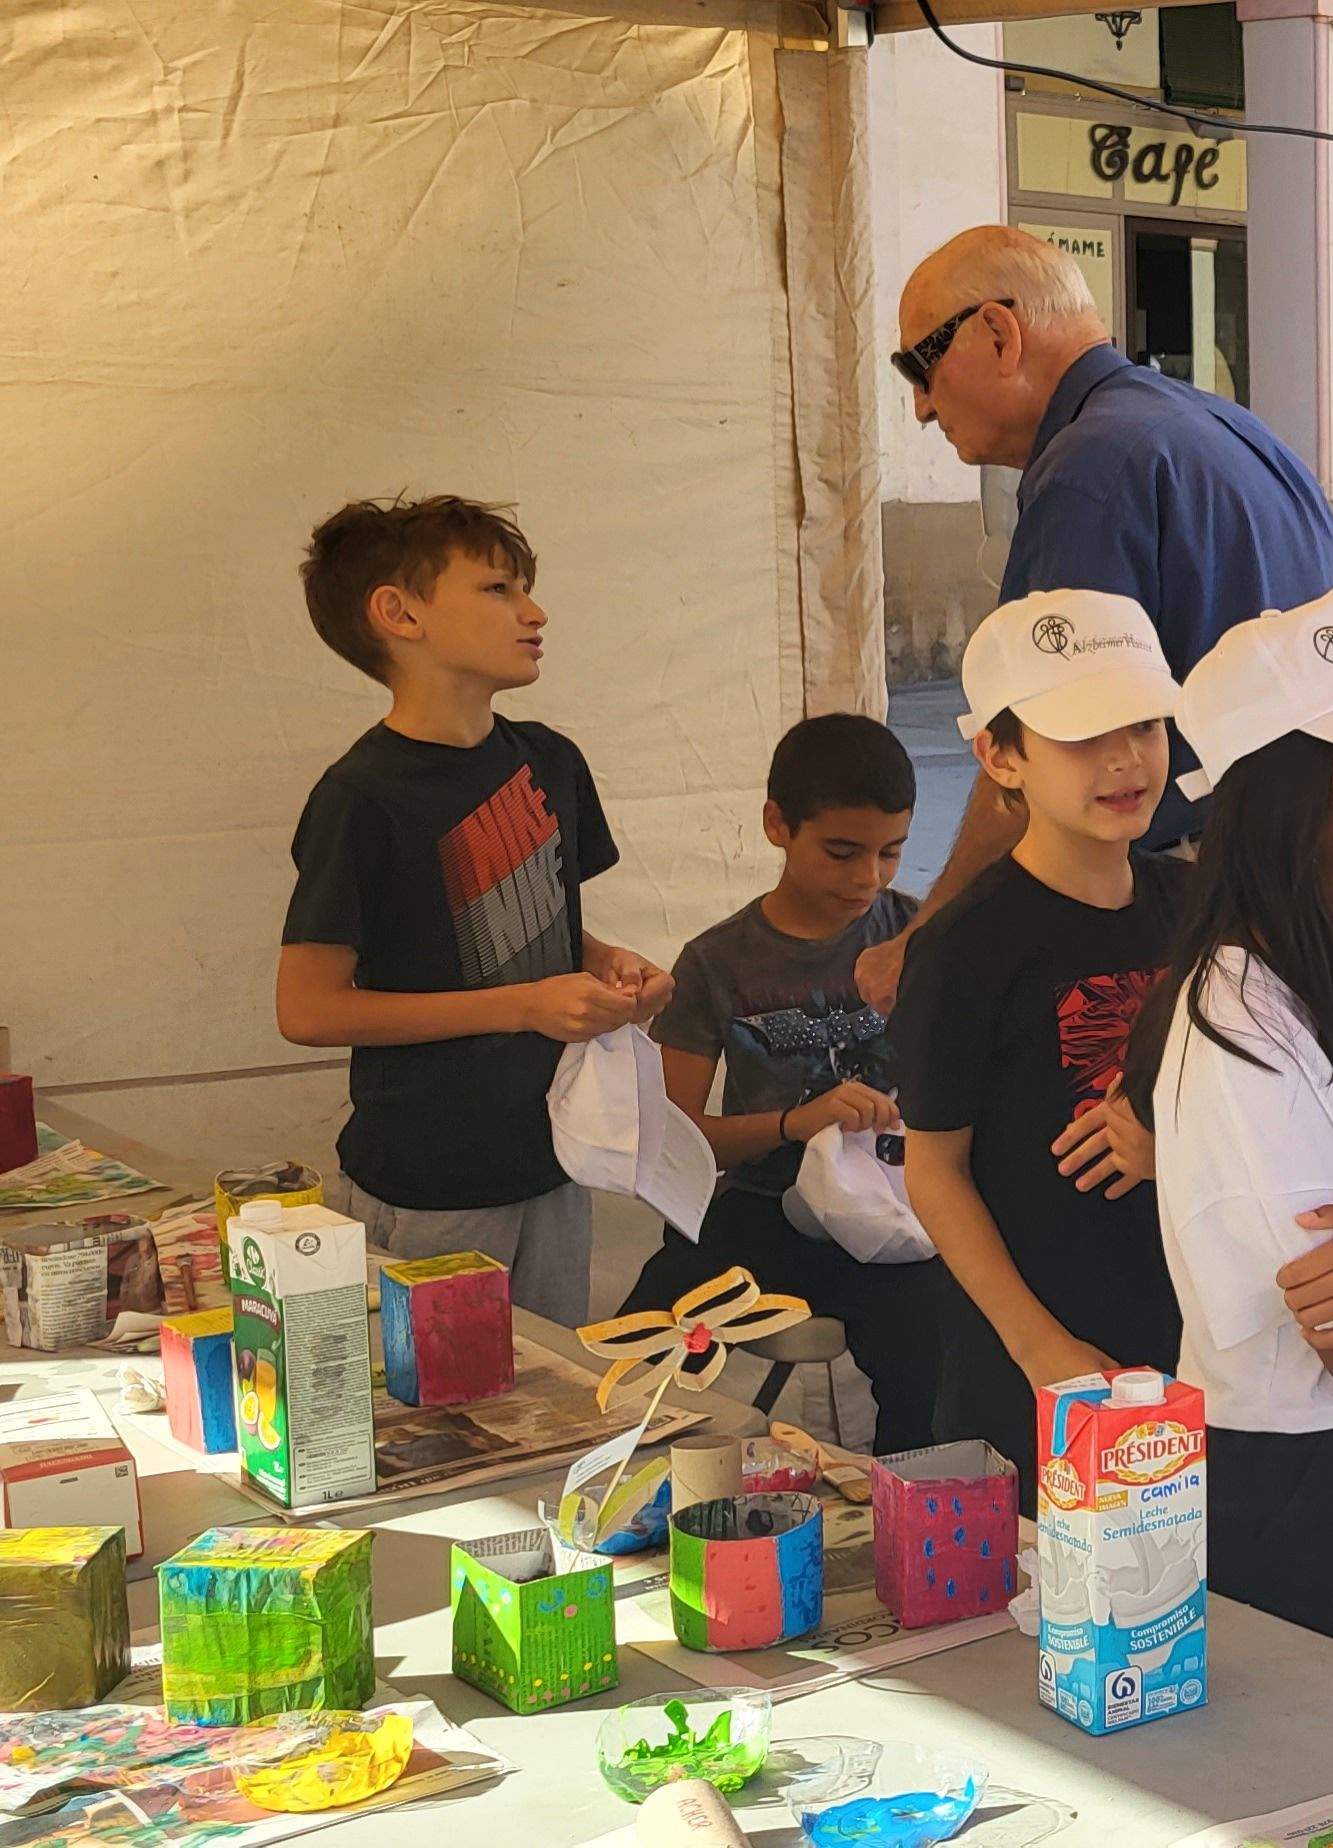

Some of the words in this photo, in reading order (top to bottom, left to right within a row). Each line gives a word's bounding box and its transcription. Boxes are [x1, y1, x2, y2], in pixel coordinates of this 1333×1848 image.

[1089, 124, 1220, 206] Café
[1103, 1432, 1203, 1470] PRÉSIDENT
[1041, 1467, 1085, 1499] PRÉSIDENT
[1141, 1474, 1200, 1502] camila
[1103, 1509, 1203, 1541] Semidesnatada
[1139, 1505, 1169, 1520] Leche
[1039, 1524, 1093, 1553] emidesnatada
[1130, 1607, 1197, 1651] SOSTENIBLE
[1131, 1604, 1189, 1639] Compromiso
